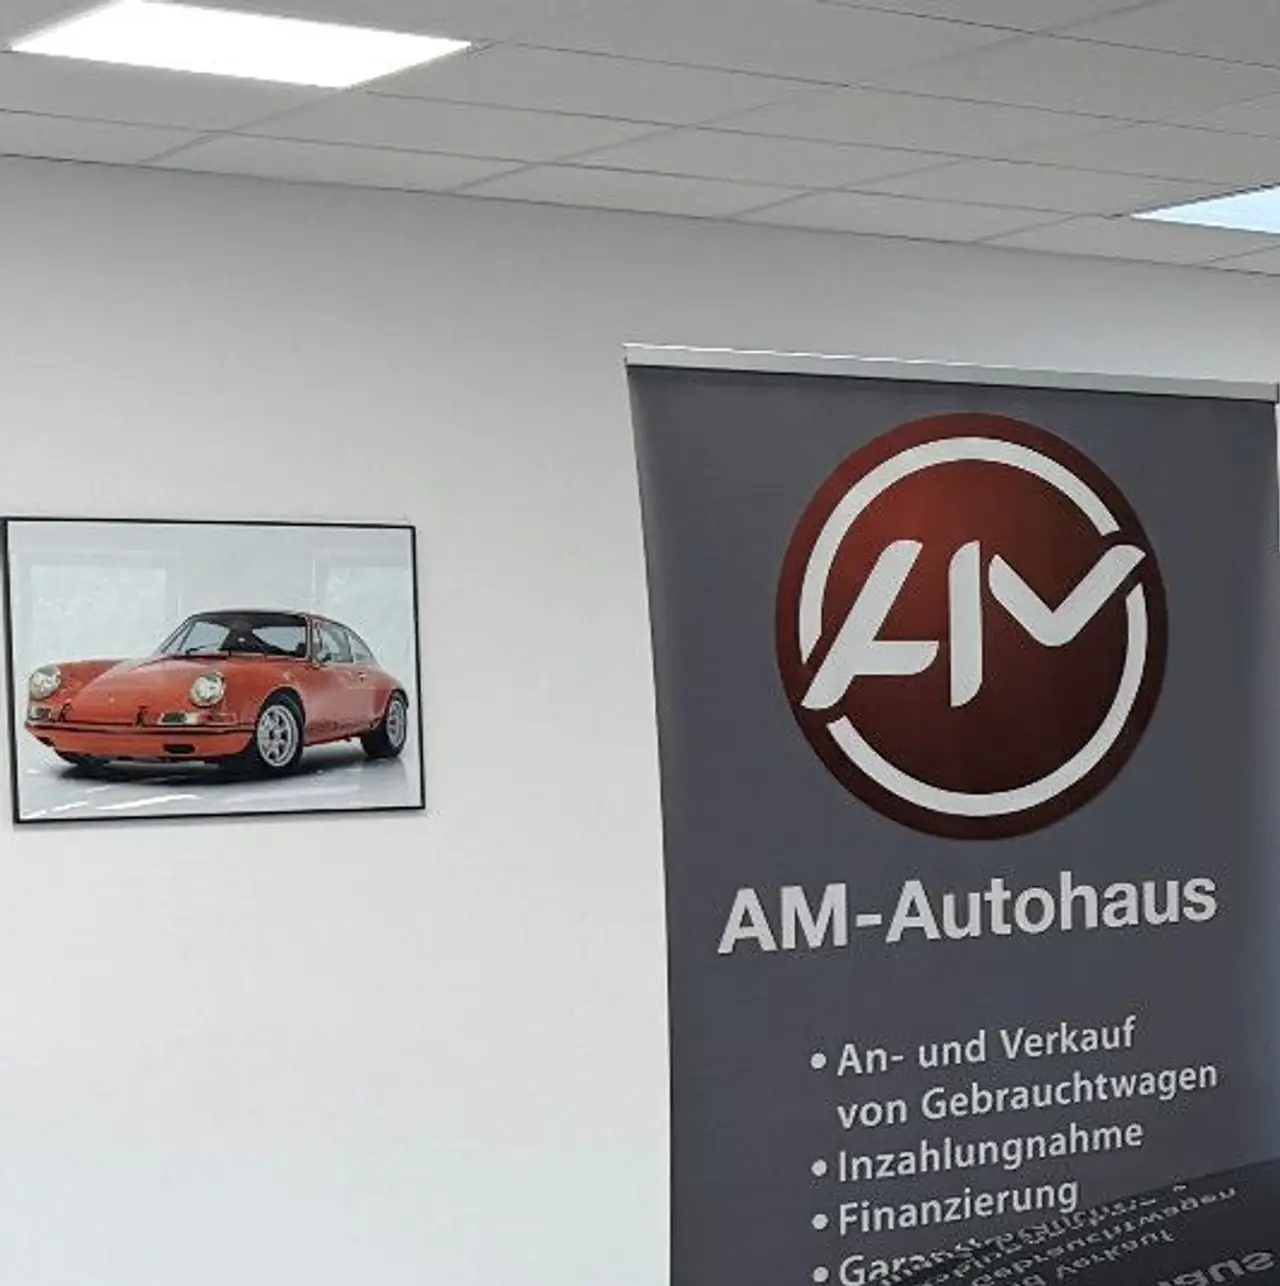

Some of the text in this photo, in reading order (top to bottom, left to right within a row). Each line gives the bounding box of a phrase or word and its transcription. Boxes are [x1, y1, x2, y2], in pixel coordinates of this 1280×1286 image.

[799, 538, 1146, 711] AM
[717, 871, 1219, 956] AM-Autohaus
[836, 1015, 1137, 1077] An- und Verkauf
[836, 1062, 1218, 1130] von Gebrauchtwagen
[838, 1120, 1144, 1182] Inzahlungnahme
[838, 1178, 1080, 1237] Finanzierung
